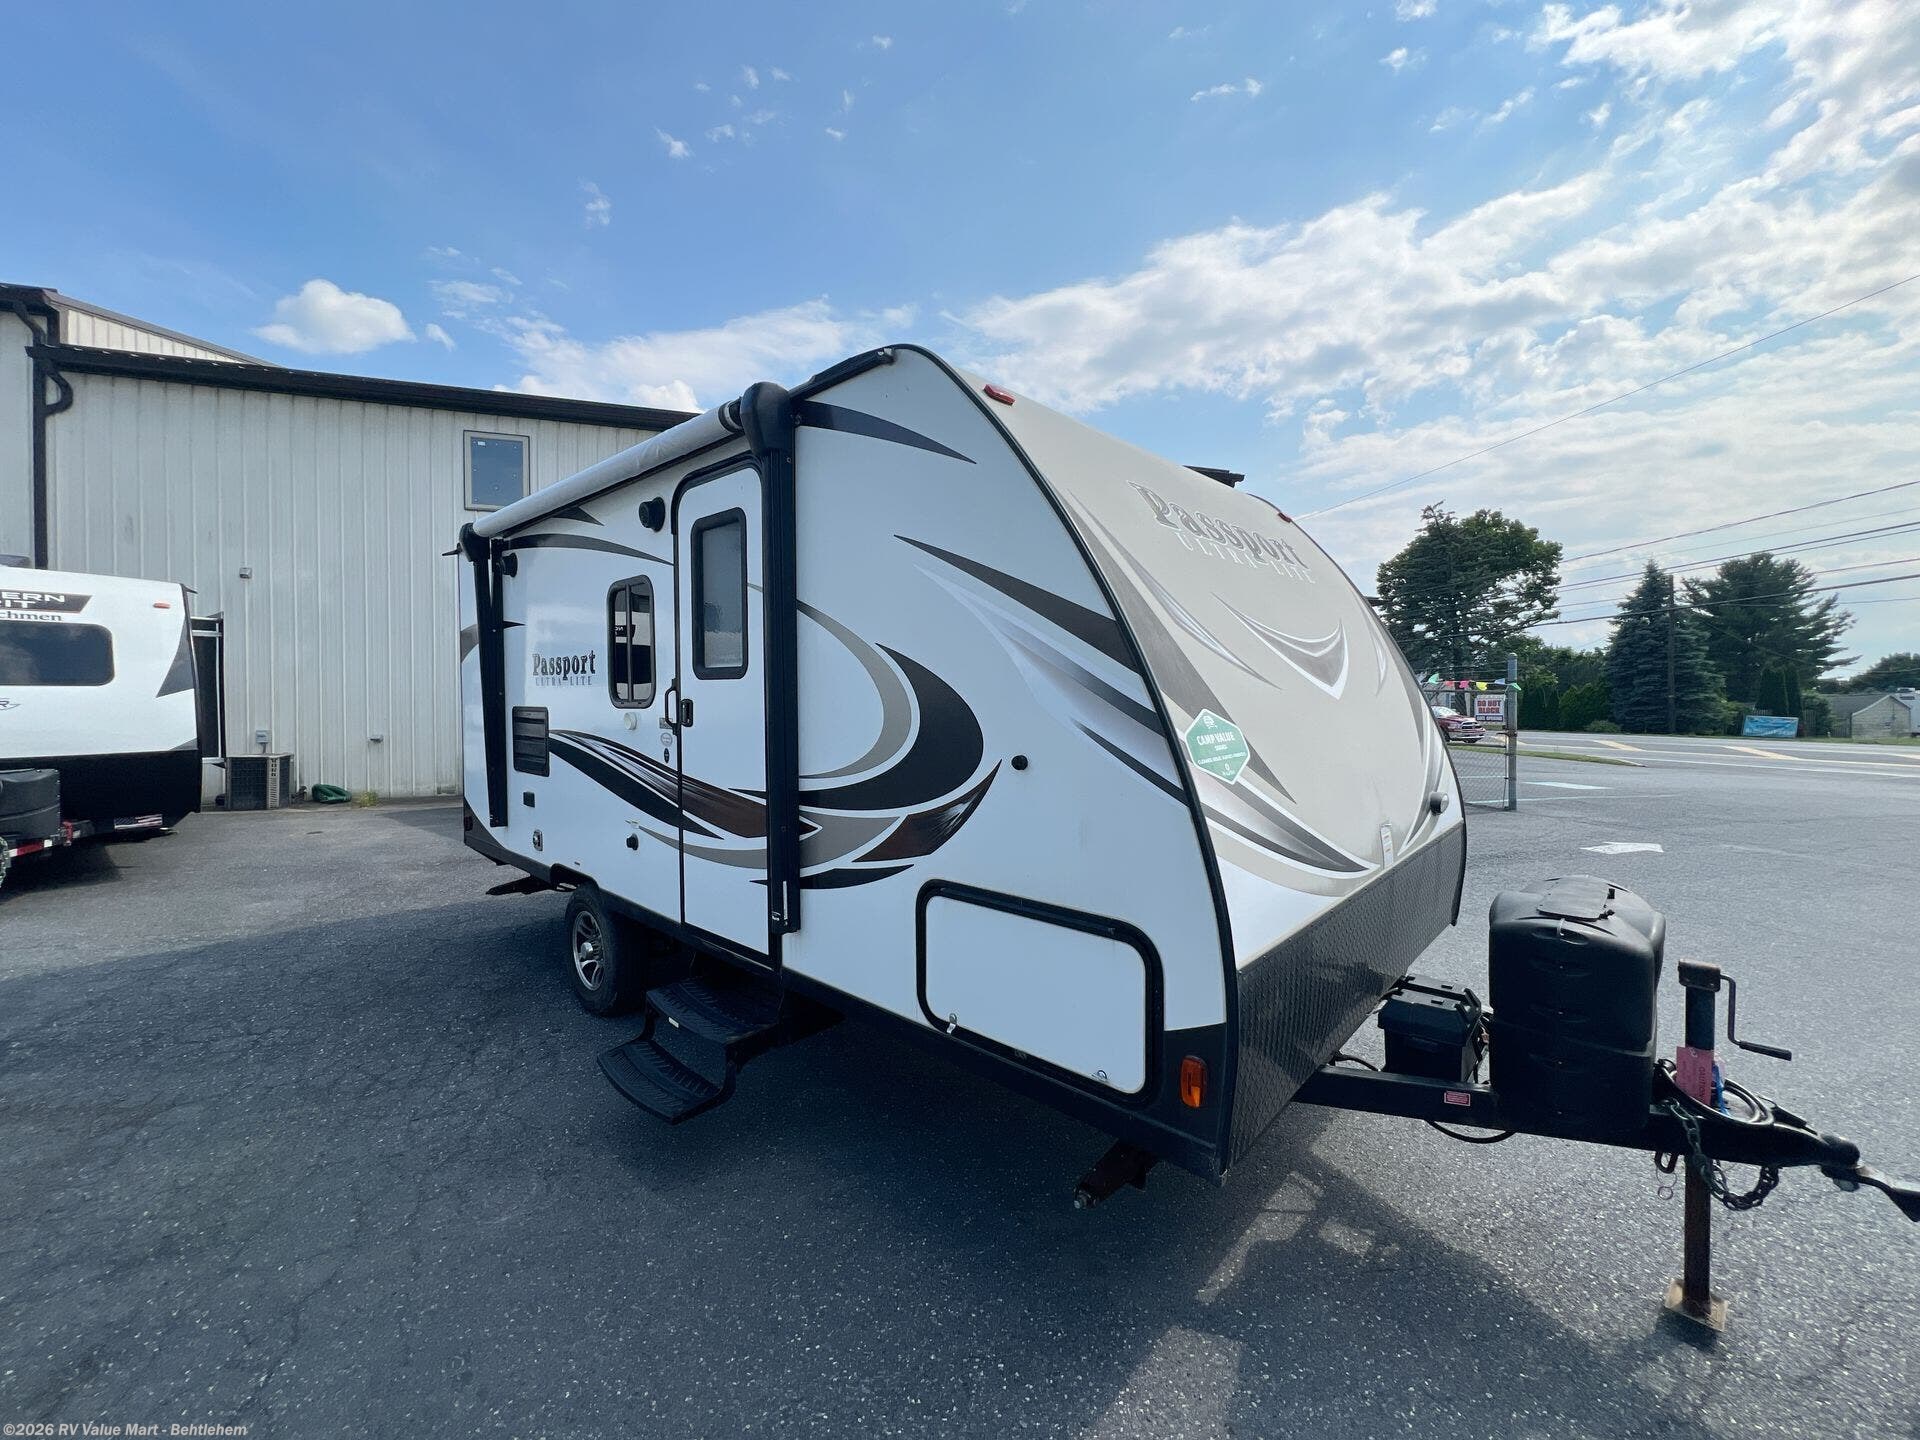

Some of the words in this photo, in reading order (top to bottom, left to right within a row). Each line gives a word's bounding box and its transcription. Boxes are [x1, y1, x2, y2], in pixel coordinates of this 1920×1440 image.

[1127, 480, 1310, 570] Passport
[0, 599, 36, 608] IT
[532, 650, 596, 681] Passport
[1196, 734, 1214, 745] CAMP
[1214, 731, 1235, 743] VALUE
